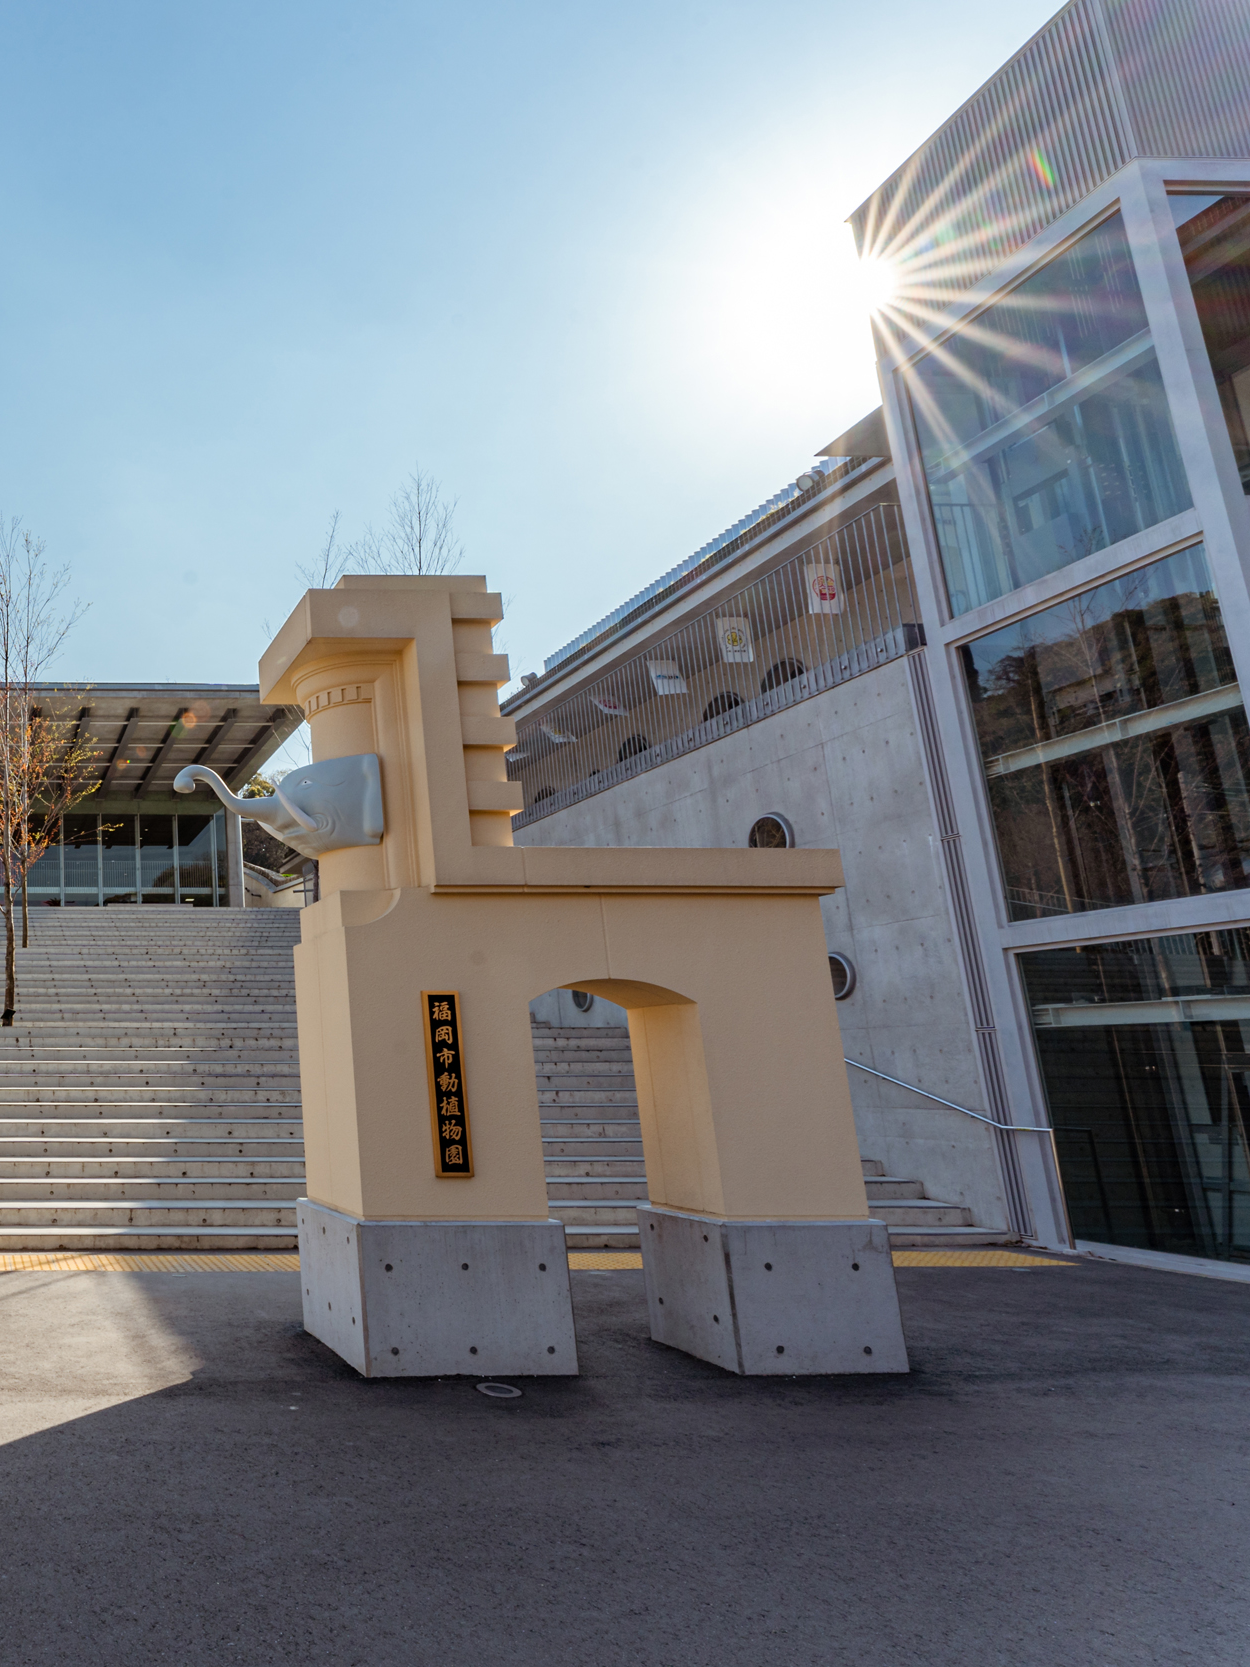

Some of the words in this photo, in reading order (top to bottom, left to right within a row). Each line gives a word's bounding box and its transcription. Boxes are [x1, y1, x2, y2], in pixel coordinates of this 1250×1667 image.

[432, 1001, 464, 1165] 福岡市動植物園
